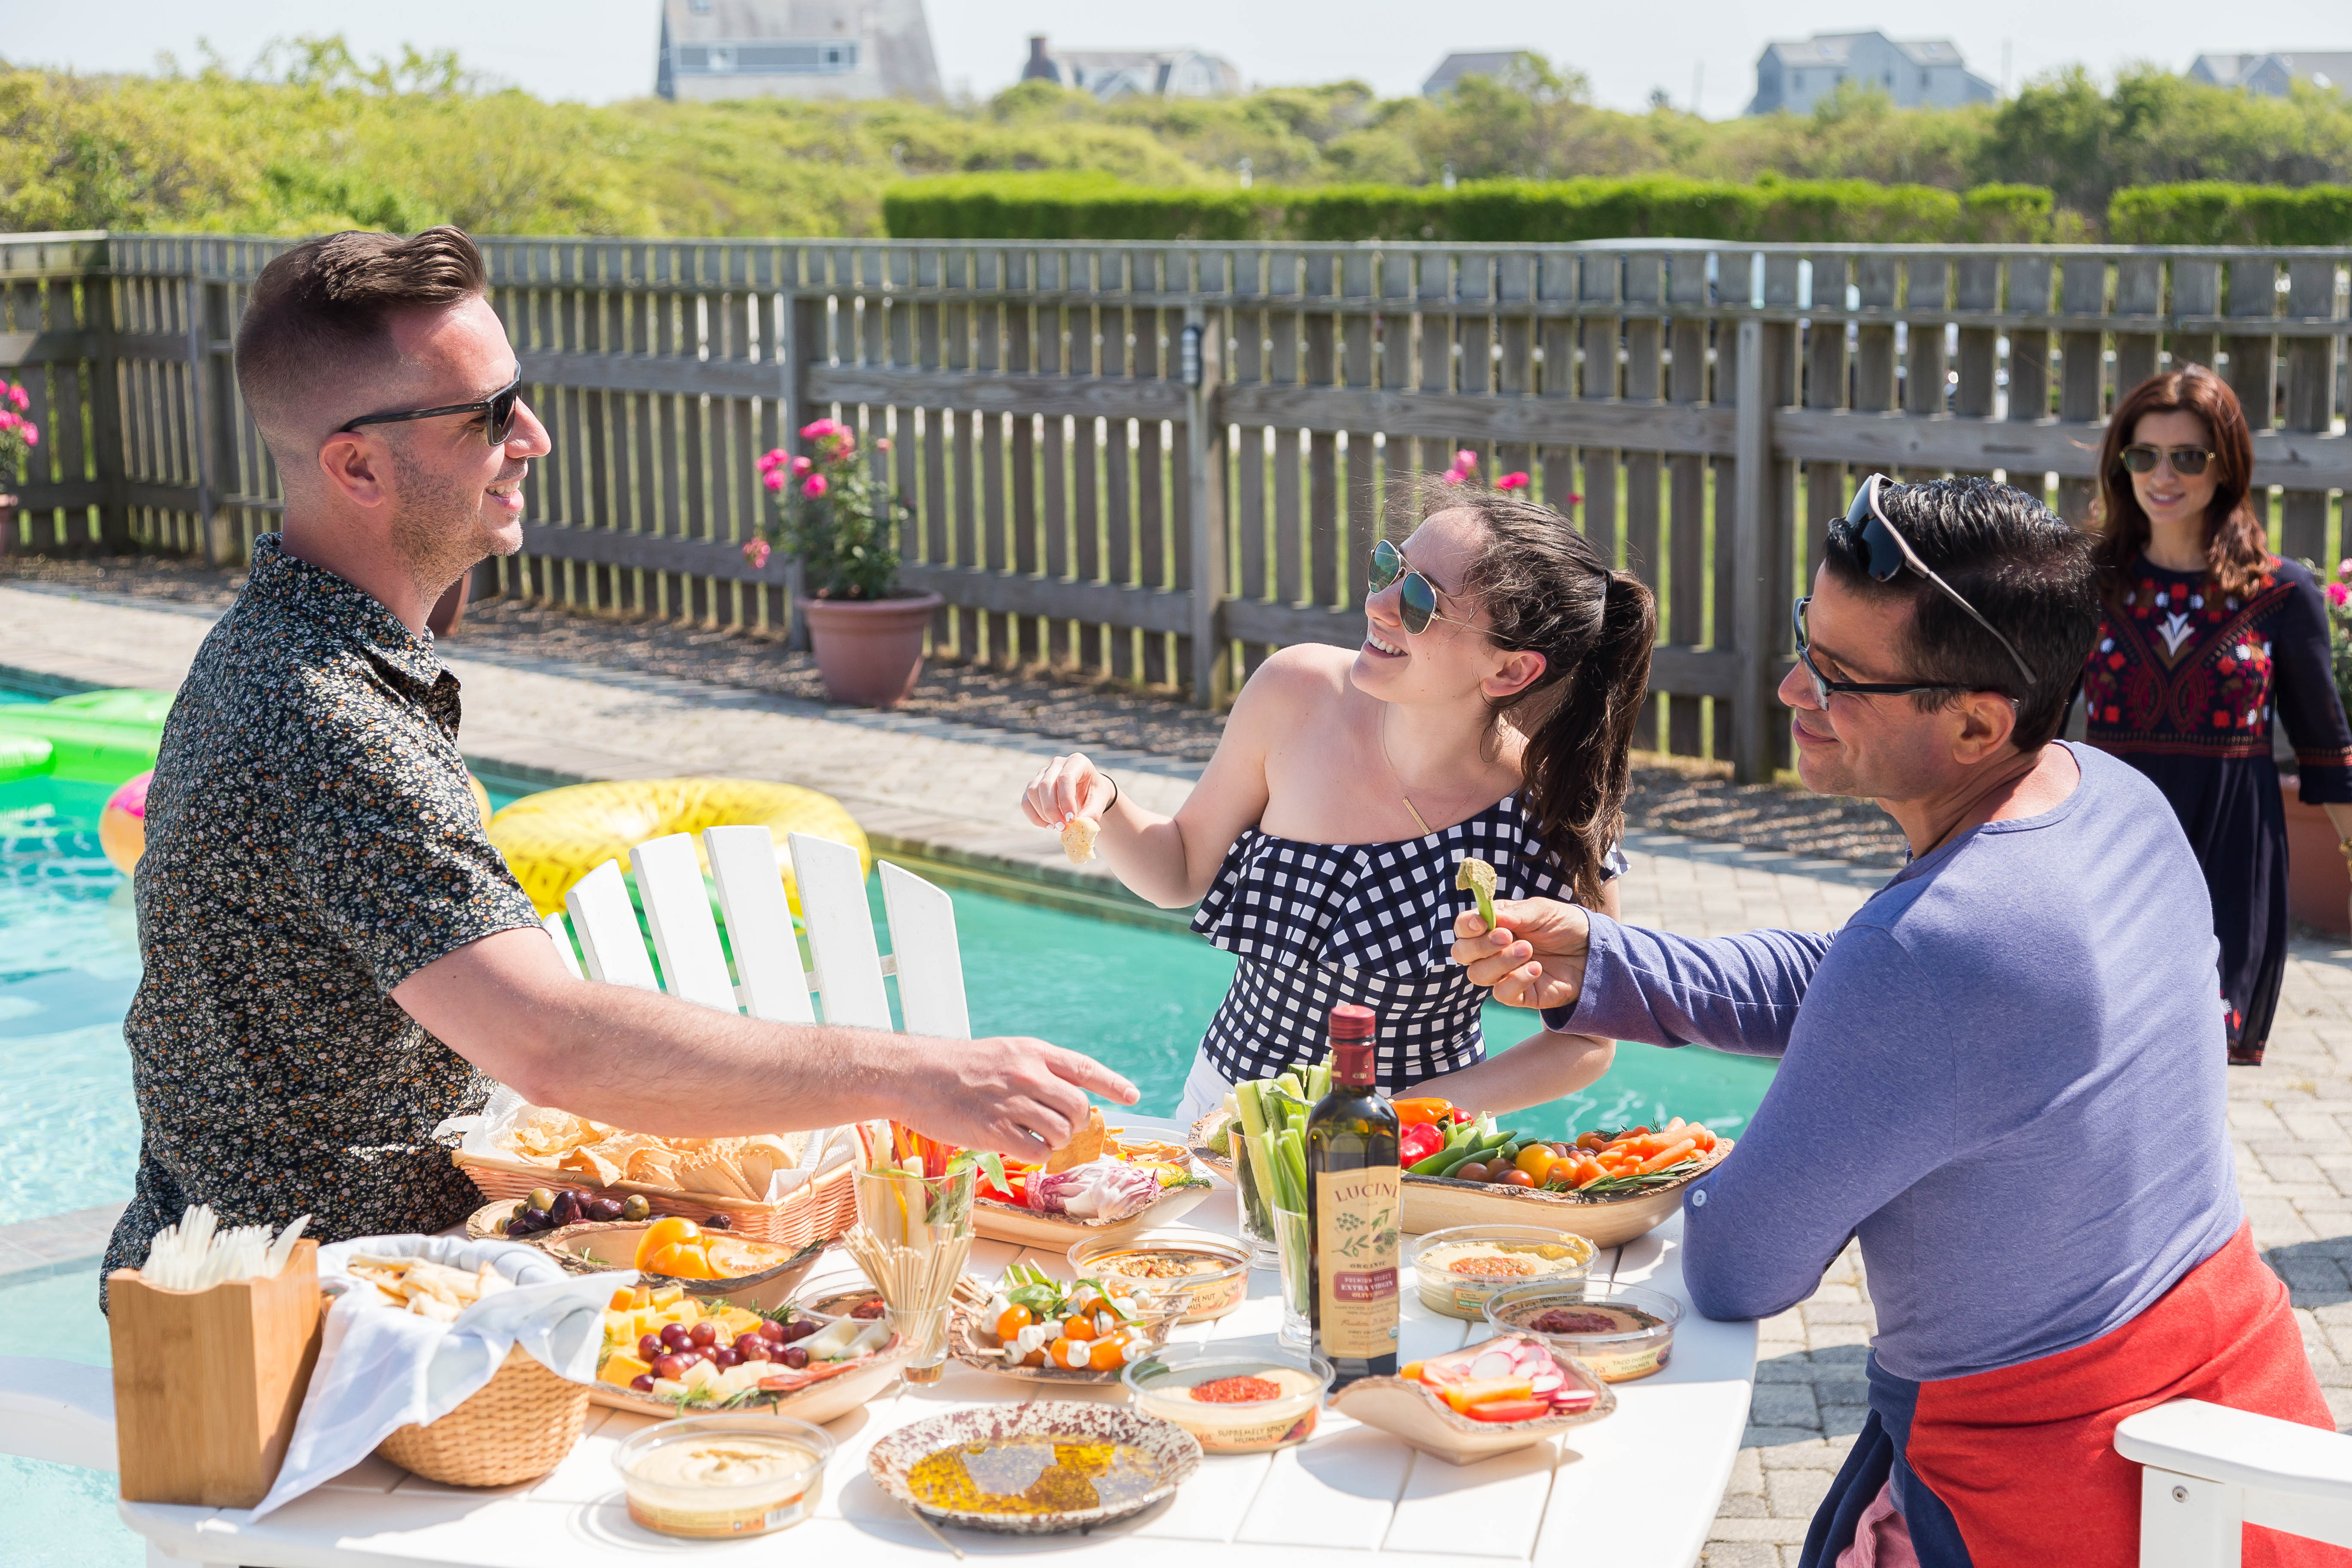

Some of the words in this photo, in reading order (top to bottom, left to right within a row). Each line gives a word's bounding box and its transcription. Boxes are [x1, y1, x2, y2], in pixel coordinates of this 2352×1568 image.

[1335, 1183, 1397, 1202] LUCINI
[1370, 1280, 1393, 1291] VIRGIN
[1202, 1293, 1216, 1302] NUT
[1632, 1352, 1657, 1363] INSPIRED
[1621, 1361, 1650, 1372] HUMMUS
[1218, 1427, 1264, 1437] SUPREMELY
[1267, 1424, 1286, 1433] SPICY
[1234, 1434, 1273, 1444] HUMMUS
